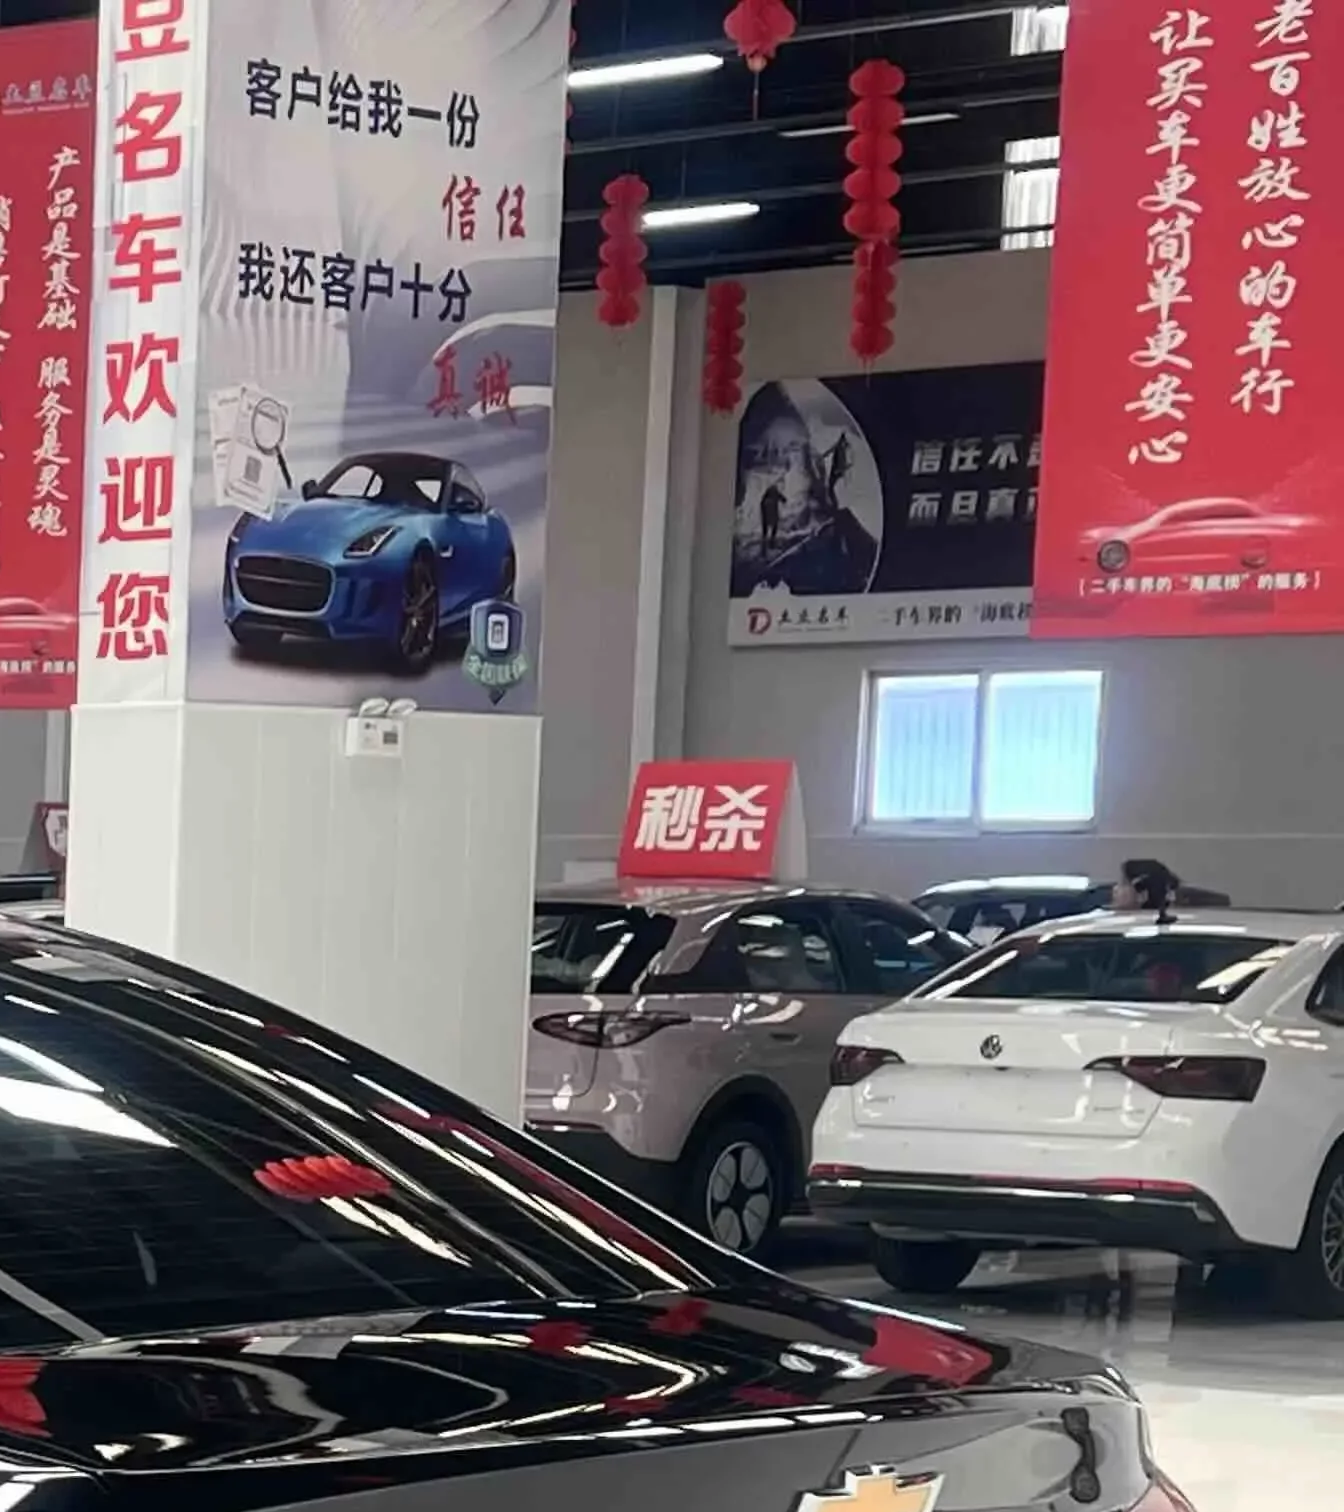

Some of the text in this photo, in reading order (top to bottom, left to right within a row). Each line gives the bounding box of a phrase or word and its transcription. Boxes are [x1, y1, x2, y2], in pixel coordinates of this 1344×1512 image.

[245, 58, 480, 150] 客户给我一份
[37, 146, 81, 330] 产品是基础
[238, 243, 473, 323] 我还客户十分
[441, 175, 527, 243] 信任
[1125, 9, 1214, 466] 让买车更简单更安心
[1229, 0, 1312, 415] 老百姓放心的车行
[96, 0, 189, 660] 豆名车欢迎您
[27, 355, 72, 538] 服务是灵魂
[634, 784, 770, 852] 秒杀
